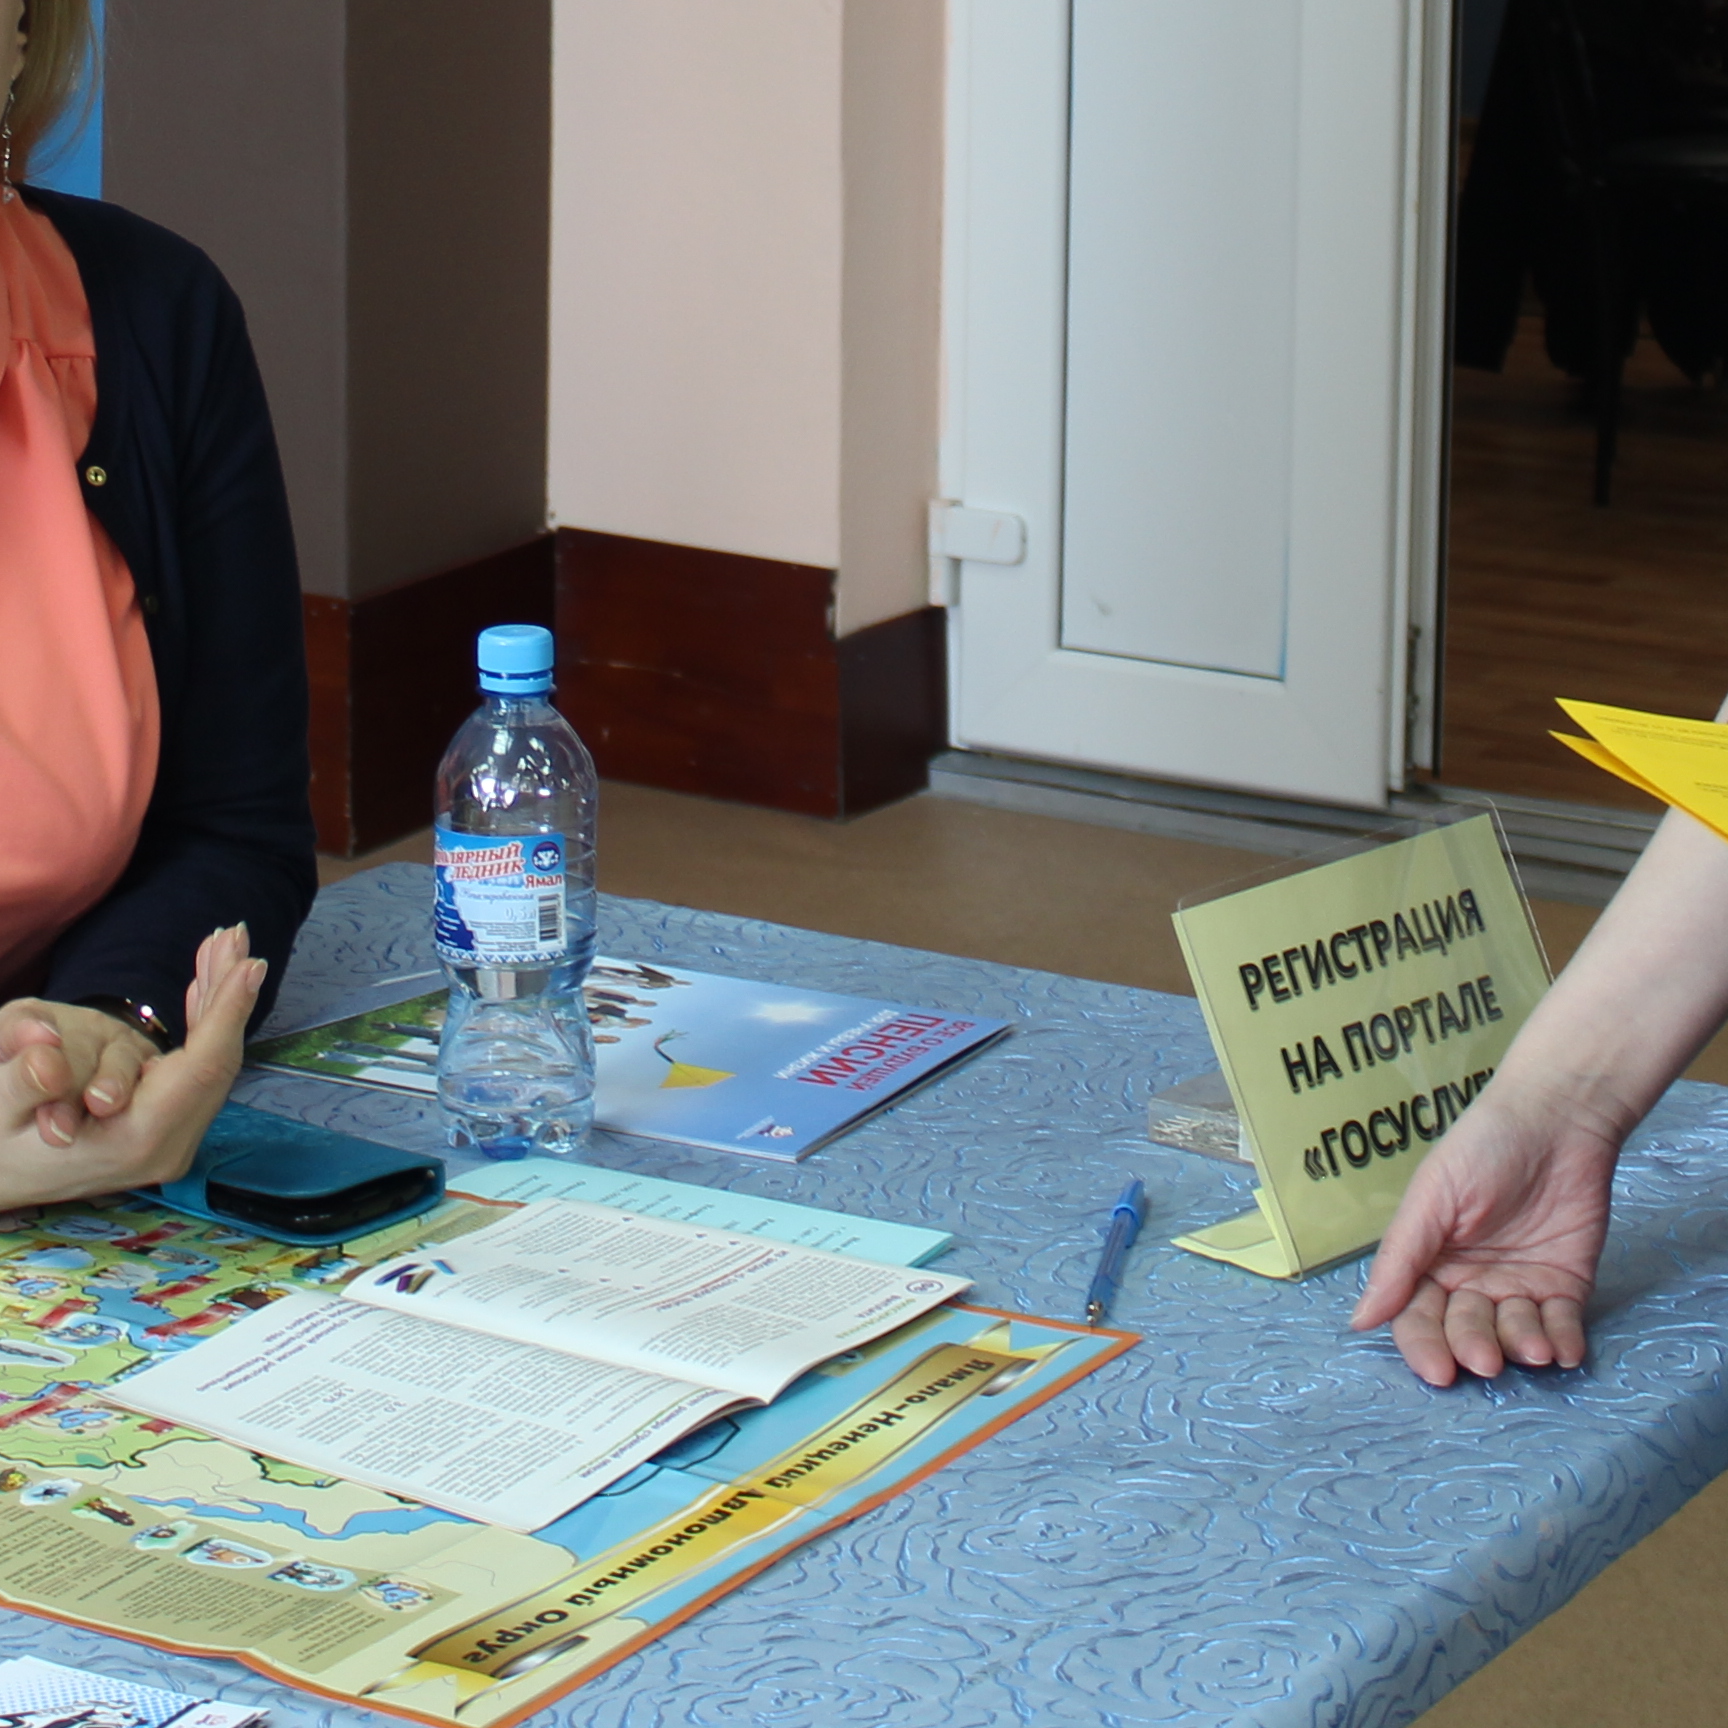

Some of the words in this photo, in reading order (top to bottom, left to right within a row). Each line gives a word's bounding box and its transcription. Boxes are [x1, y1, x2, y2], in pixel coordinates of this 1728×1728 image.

[452, 859, 525, 880] ЛЕДНИК
[525, 874, 563, 889] Ямал
[1238, 888, 1485, 1010] РЕГИСТРАЦИЯ
[796, 1013, 947, 1087] ПЕНСИИ
[921, 1037, 943, 1047] О
[935, 1020, 976, 1039] ВСЕ
[1280, 1034, 1344, 1092] НА
[1342, 974, 1504, 1074] ПОРТАЛЕ
[846, 1045, 931, 1092] БУДУЩЕЙ
[770, 1358, 995, 1490] Ямало-Ненецкий
[570, 1488, 766, 1609] Автономный
[462, 1608, 570, 1666] Округ
